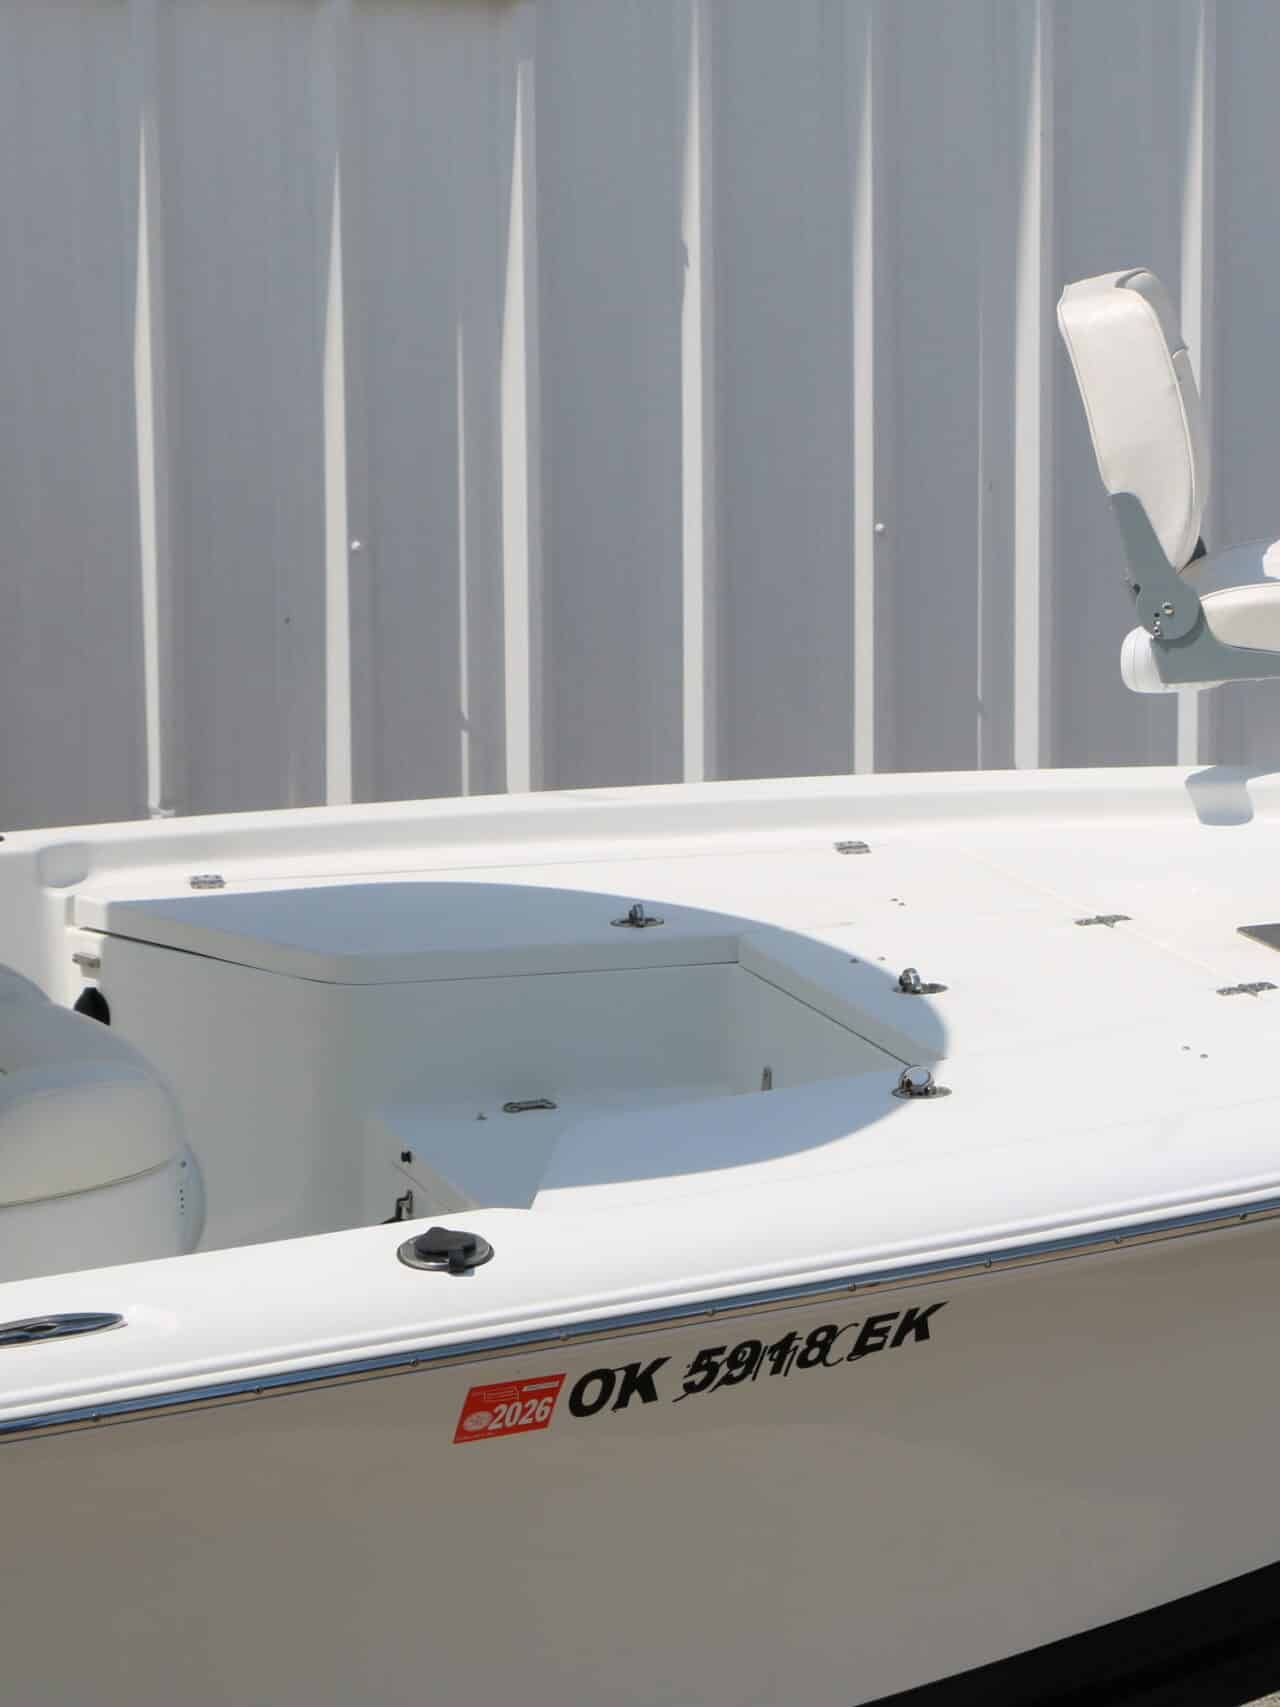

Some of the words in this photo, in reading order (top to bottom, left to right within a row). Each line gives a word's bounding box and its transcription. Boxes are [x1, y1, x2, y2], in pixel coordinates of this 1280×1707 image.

[568, 1356, 672, 1418] OK
[849, 1302, 948, 1361] EK
[487, 1396, 553, 1430] 2026
